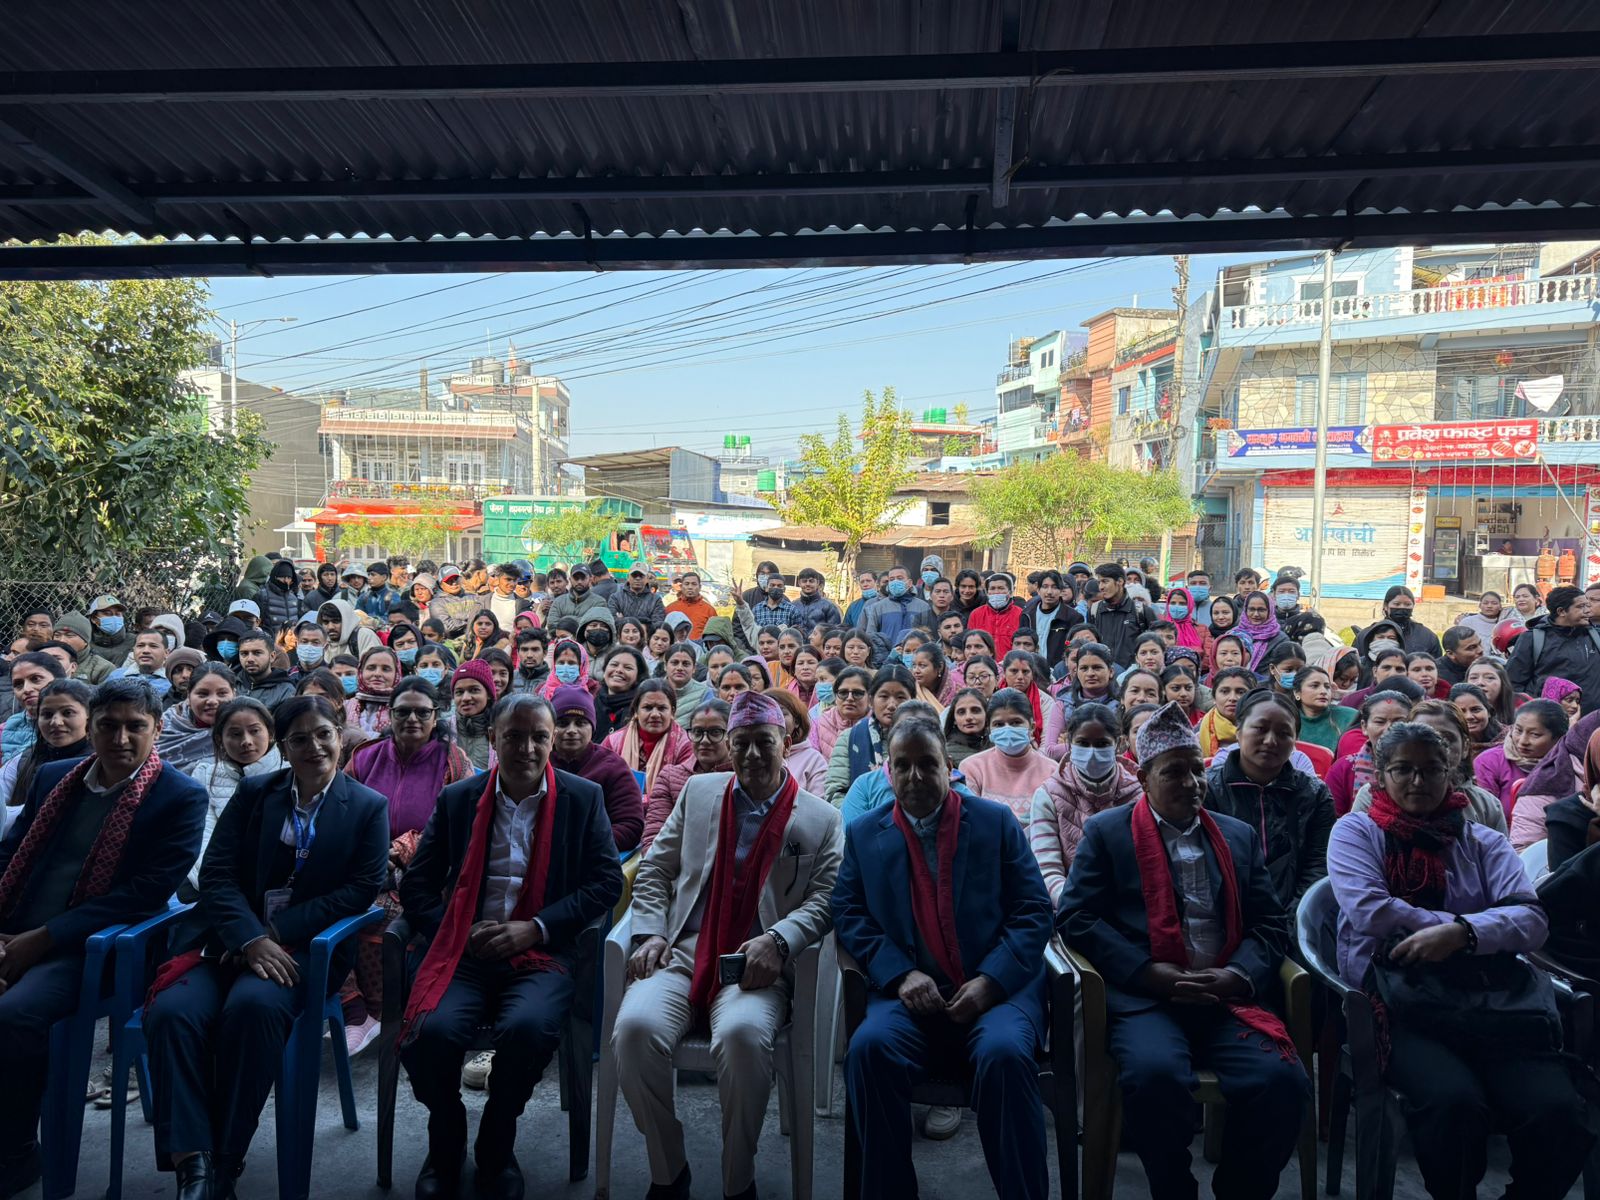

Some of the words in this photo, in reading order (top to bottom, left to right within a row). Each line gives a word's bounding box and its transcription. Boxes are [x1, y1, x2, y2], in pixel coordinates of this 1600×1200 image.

[1397, 426, 1440, 443] प्रवेश
[1443, 426, 1495, 441] फास्ट
[1497, 425, 1533, 442] फुड
